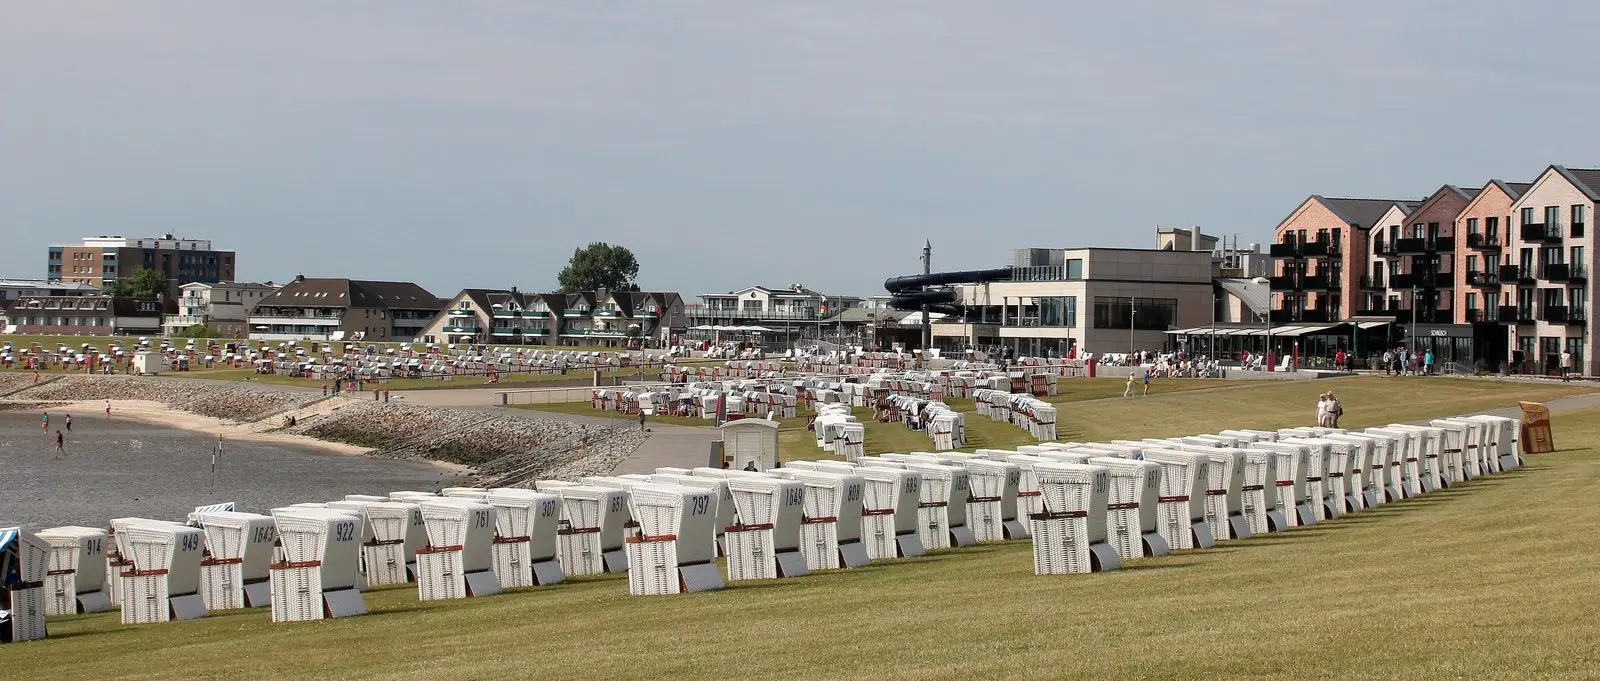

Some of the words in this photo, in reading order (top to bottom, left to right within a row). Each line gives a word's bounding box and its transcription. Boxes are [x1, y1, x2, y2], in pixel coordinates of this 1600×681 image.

[691, 495, 709, 516] 797
[785, 487, 803, 506] 1649
[542, 500, 556, 517] 307
[475, 510, 489, 529] 761
[253, 526, 275, 544] 1643
[336, 522, 354, 542] 922
[87, 538, 102, 556] 914
[182, 533, 199, 552] 949
